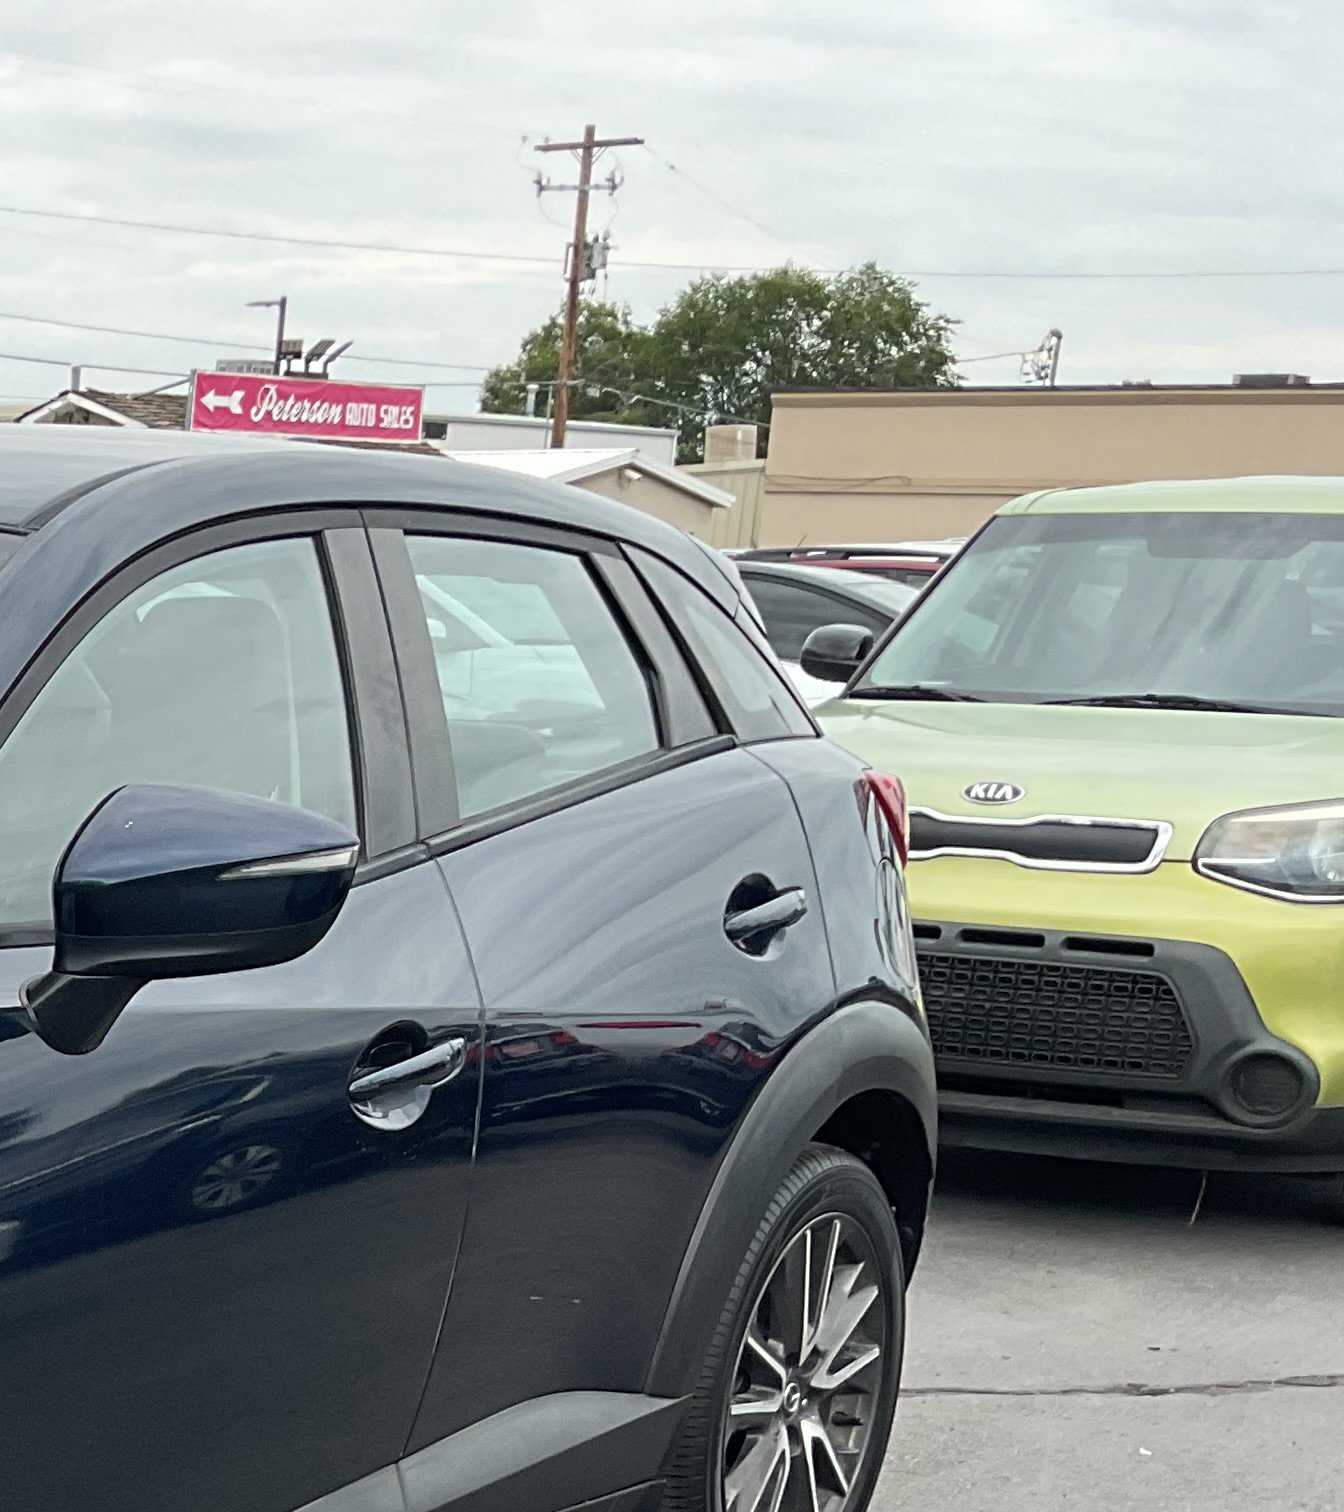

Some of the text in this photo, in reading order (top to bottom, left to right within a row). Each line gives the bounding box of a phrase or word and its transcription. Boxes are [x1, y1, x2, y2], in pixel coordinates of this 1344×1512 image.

[250, 383, 415, 429] Peterson AUTO SALES
[970, 783, 1013, 799] KIA
